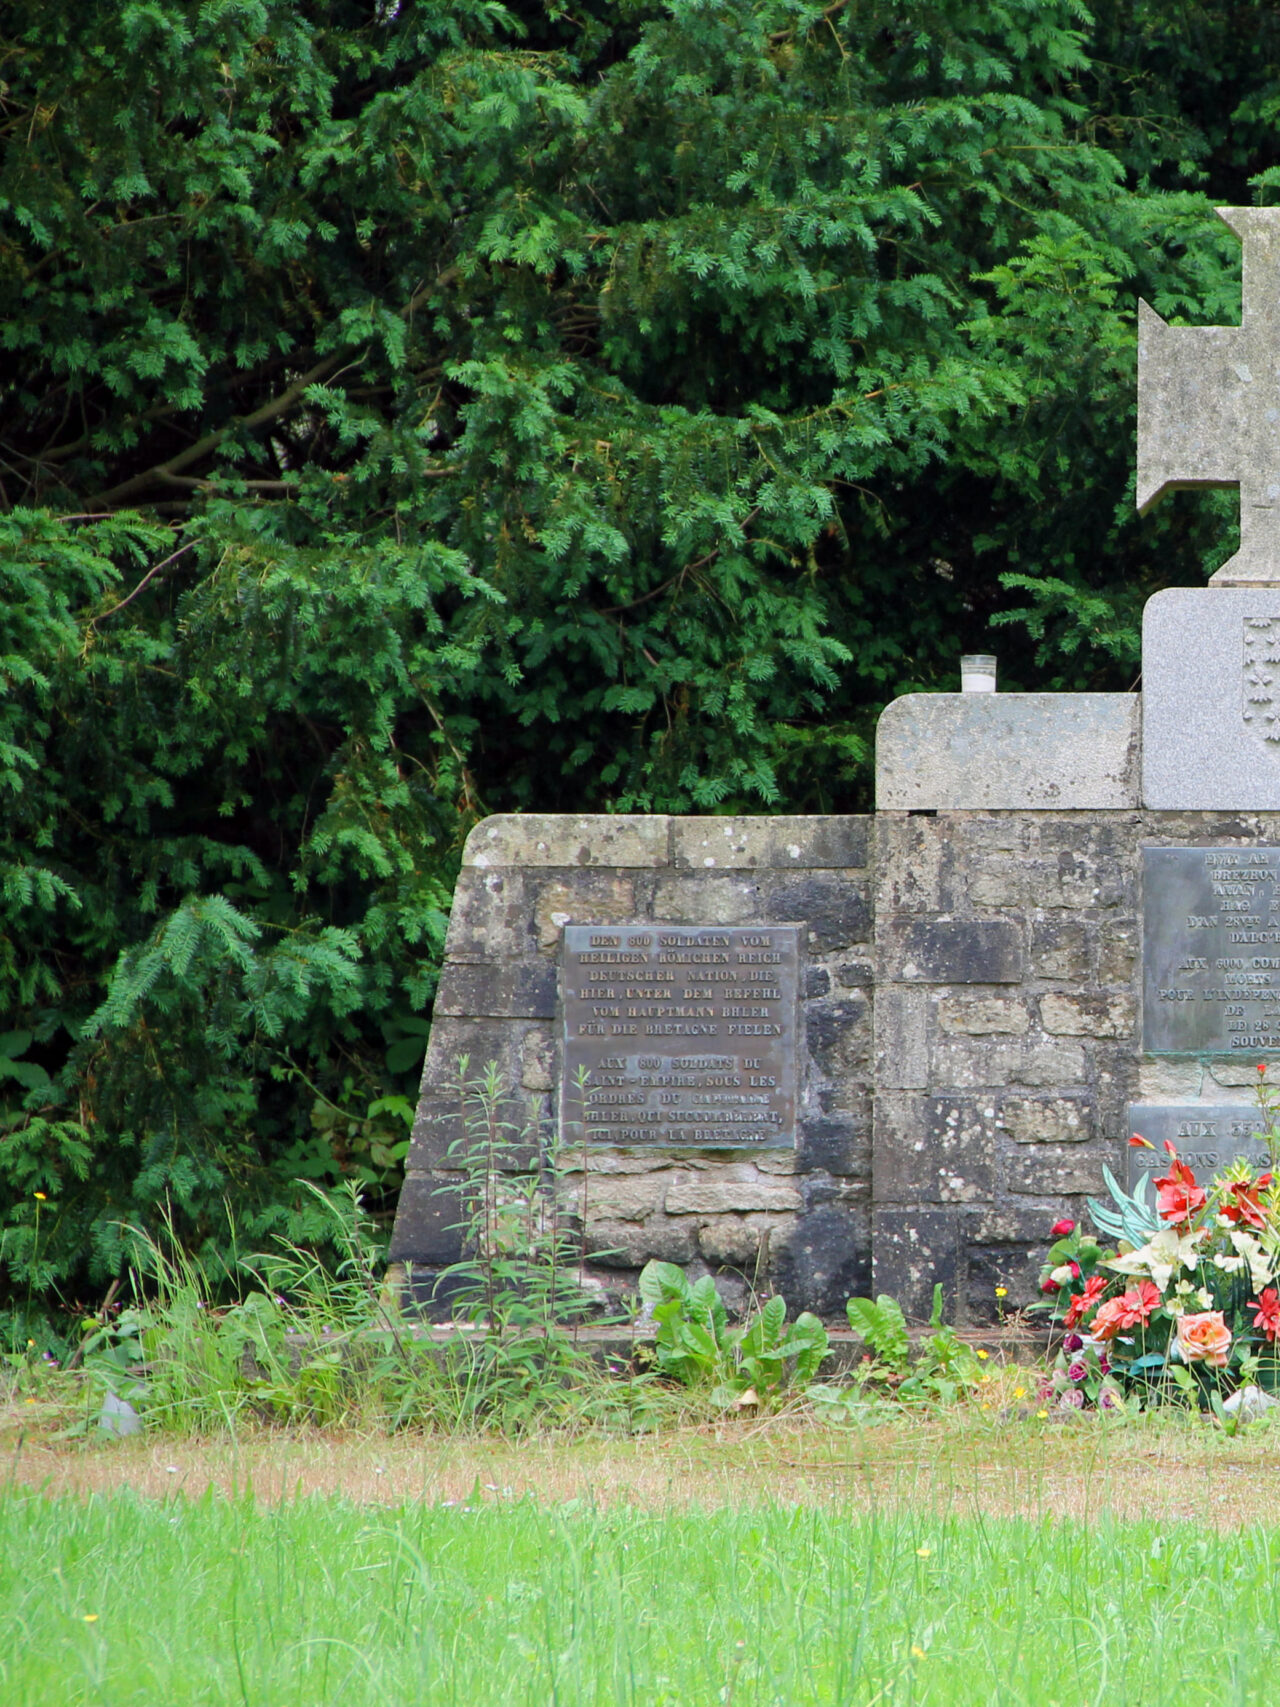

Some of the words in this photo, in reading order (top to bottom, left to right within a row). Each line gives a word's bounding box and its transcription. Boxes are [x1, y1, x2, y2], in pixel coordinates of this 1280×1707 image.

[1248, 853, 1269, 865] AR
[1267, 915, 1278, 928] A
[590, 936, 619, 947] DEN
[628, 936, 650, 947] 800
[659, 936, 730, 947] SOLDATEN
[741, 936, 772, 947] VOM
[578, 952, 649, 964] HEILIGEN
[658, 949, 730, 964] RÖMICHEN
[738, 952, 782, 964] REICH
[1178, 957, 1207, 970] AUX
[1216, 957, 1243, 970] 6000
[588, 970, 675, 982] DEUTSCHER
[1224, 973, 1271, 985] MORTS
[626, 988, 672, 1000] UNTER
[683, 988, 713, 1000] DEM
[724, 988, 781, 1000] BEFEHL
[1158, 989, 1196, 1001] POUR
[592, 1006, 620, 1018] VOM
[626, 1006, 715, 1018] HAUPTMANN
[1224, 1005, 1246, 1017] DE
[578, 1021, 605, 1036] FÜR
[611, 1024, 638, 1036] DIE
[645, 1024, 718, 1036] BRETAGNE
[727, 1024, 783, 1036] FIELEN
[1227, 1020, 1247, 1032] LE
[1253, 1020, 1269, 1032] 28
[597, 1058, 627, 1070] AUX
[638, 1058, 662, 1070] 800
[671, 1058, 734, 1070] SOLDATS
[743, 1058, 762, 1070] DU
[706, 1076, 741, 1088] SOUS
[749, 1076, 776, 1088] LES
[589, 1093, 645, 1105] ORDRES
[662, 1093, 682, 1105] DU
[638, 1111, 663, 1124] QUI
[622, 1129, 657, 1141] POUR
[668, 1129, 686, 1141] LA
[694, 1129, 767, 1141] BRETAGNE
[1177, 1121, 1217, 1138] AUX
